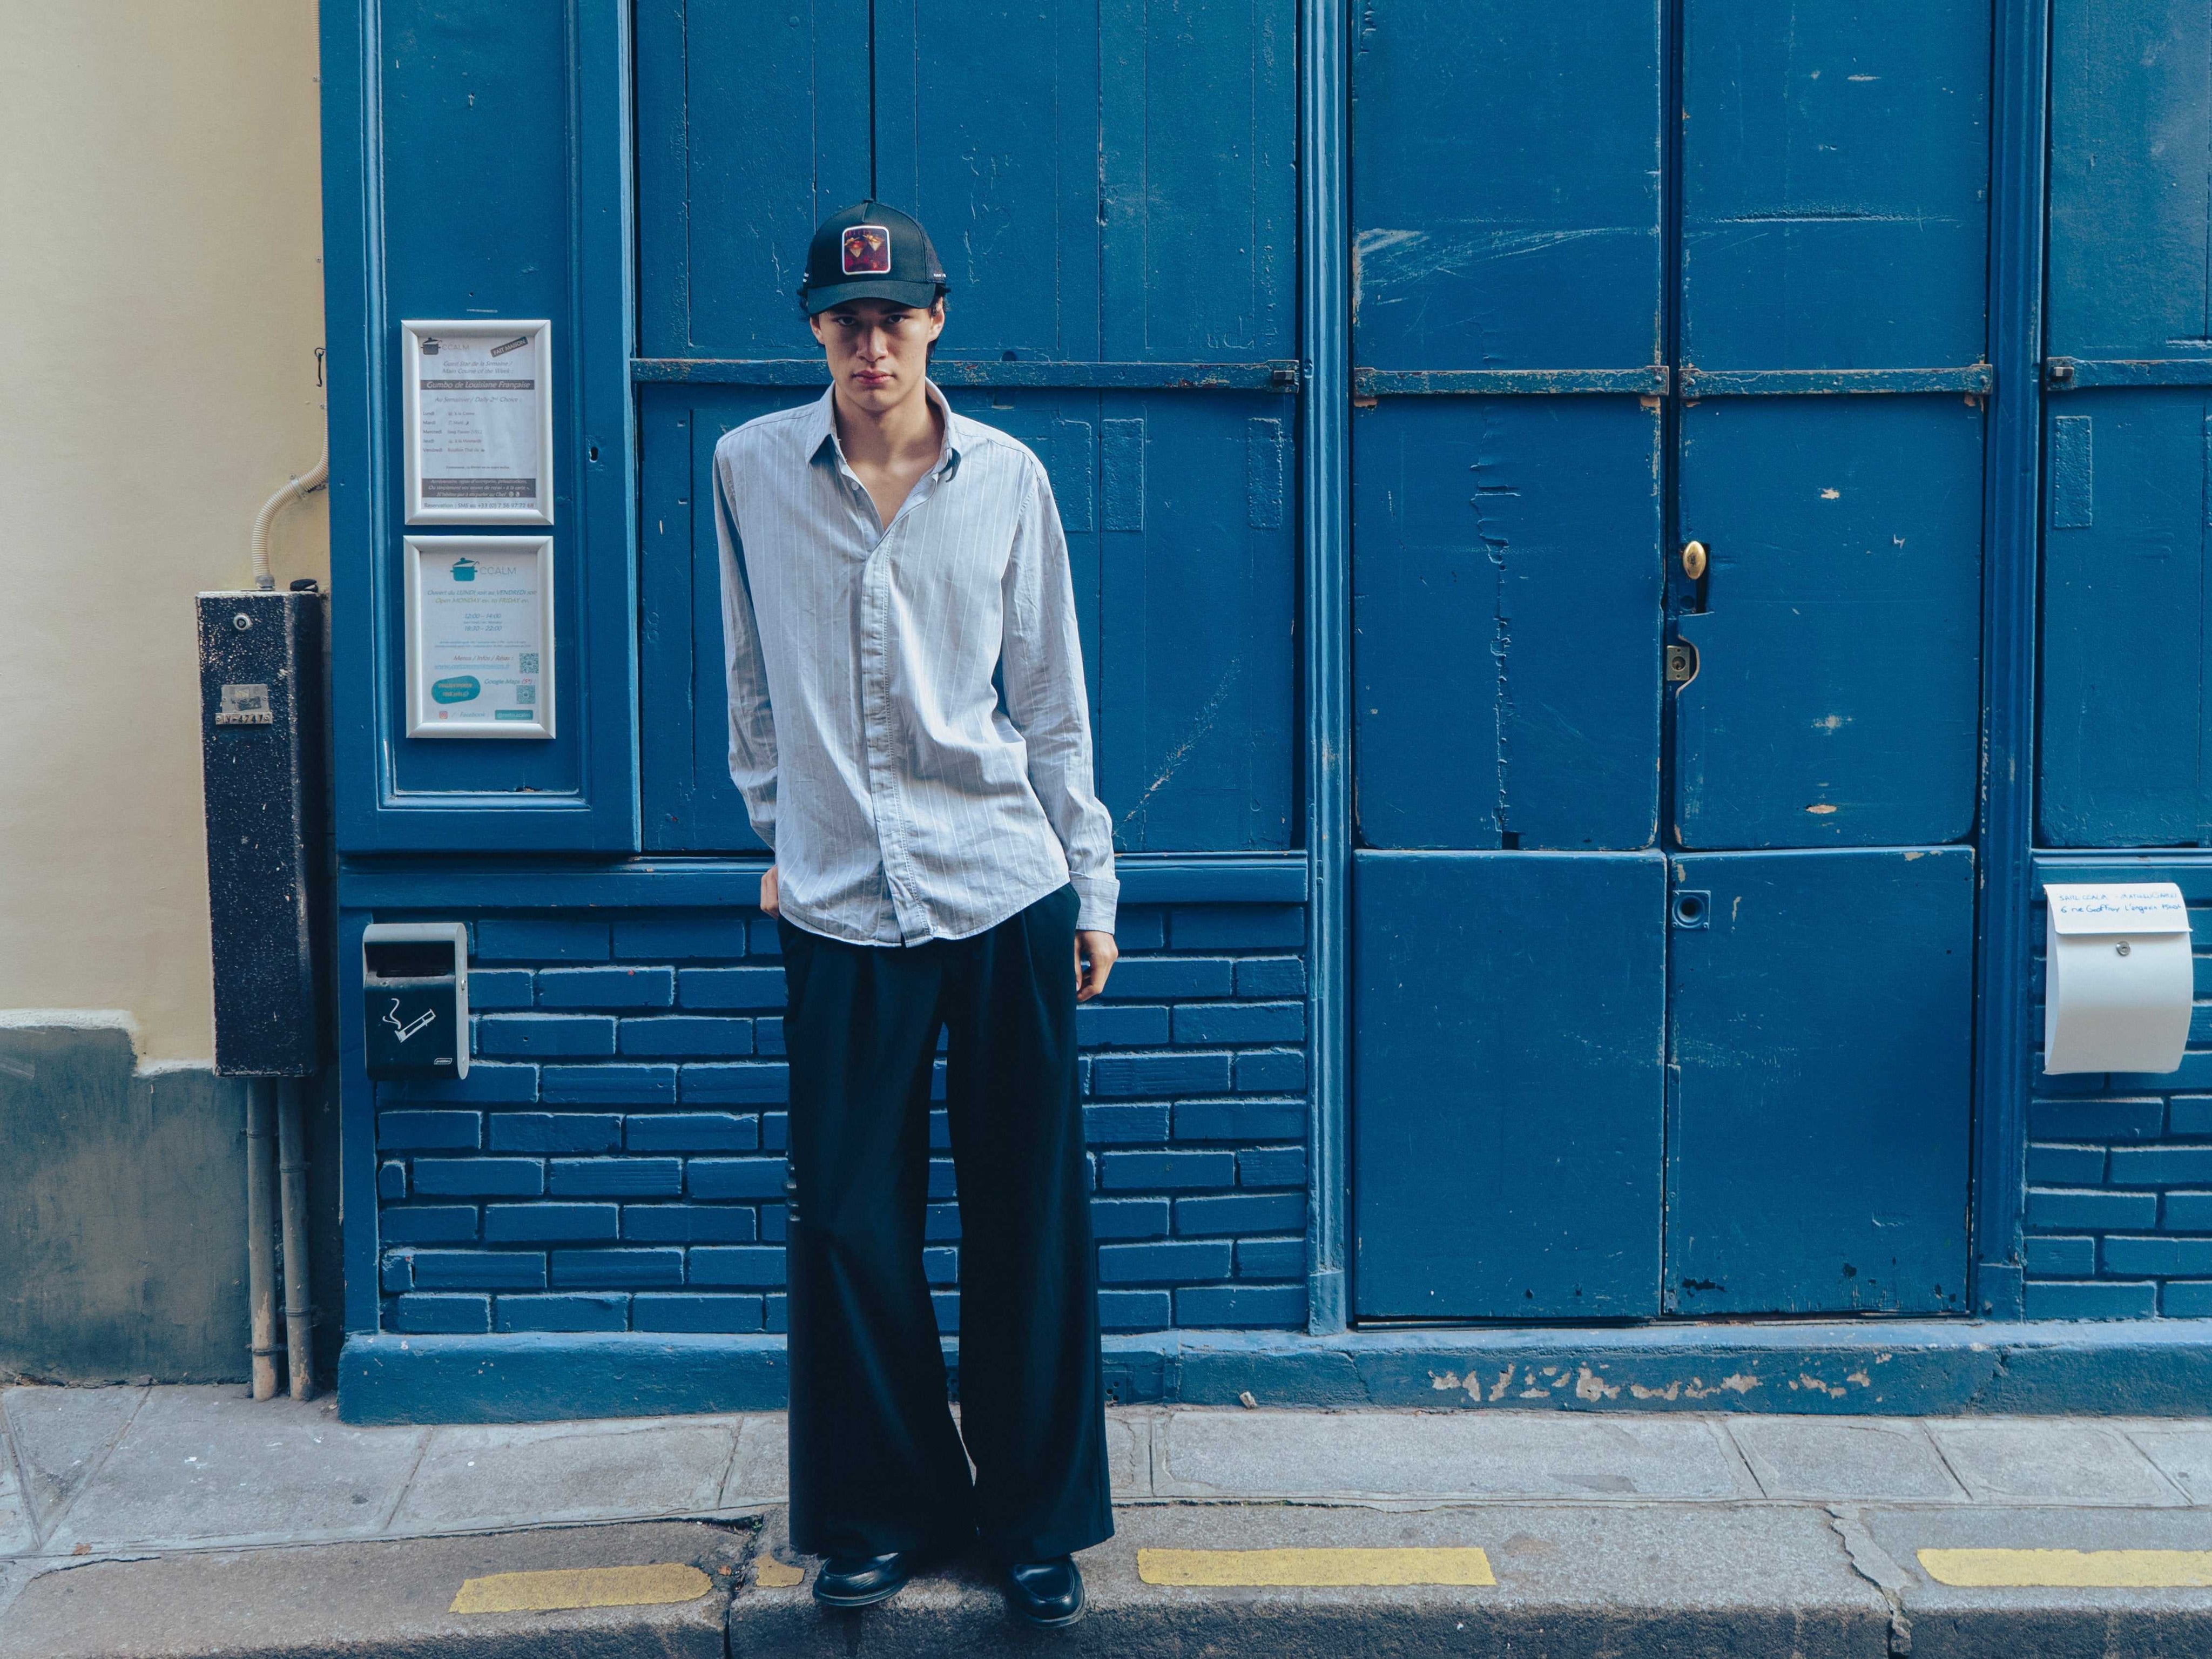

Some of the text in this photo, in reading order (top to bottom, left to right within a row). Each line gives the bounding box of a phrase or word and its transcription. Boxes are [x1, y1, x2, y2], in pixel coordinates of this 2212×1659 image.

[493, 340, 525, 355] FAIT MAISON
[499, 381, 530, 389] Française
[480, 567, 516, 575] CCALM
